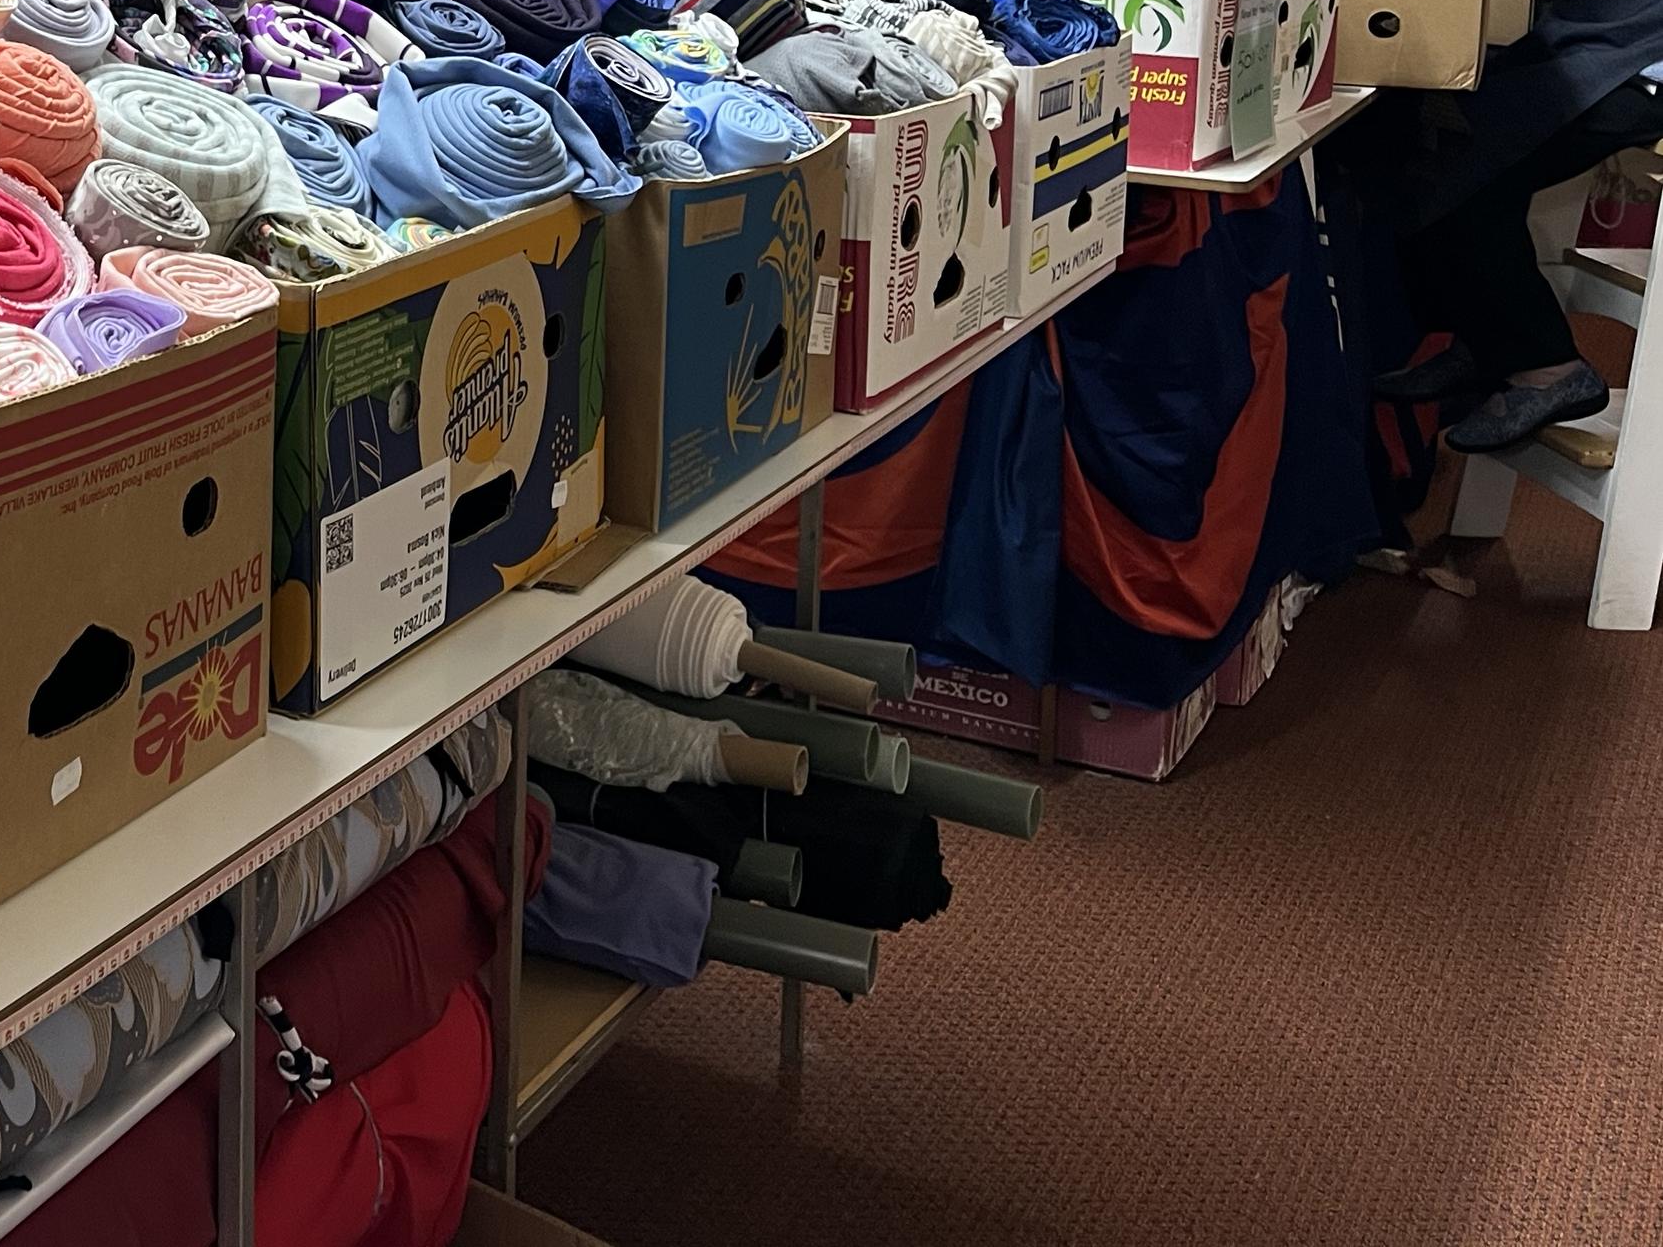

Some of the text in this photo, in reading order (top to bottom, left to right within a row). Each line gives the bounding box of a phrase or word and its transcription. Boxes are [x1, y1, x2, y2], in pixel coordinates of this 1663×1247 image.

[1140, 68, 1188, 87] super
[1141, 88, 1187, 106] Fresh
[883, 124, 906, 344] super premium quality
[1050, 257, 1070, 285] PACK
[168, 427, 201, 453] FRESH
[137, 442, 167, 468] FRUIT
[81, 454, 136, 489] COMPANY,
[28, 476, 79, 505] WESTLAKE
[144, 552, 263, 660] BANANAS
[328, 658, 356, 683] Delivery
[915, 674, 1009, 708] MEXICO
[132, 633, 262, 785] Dole
